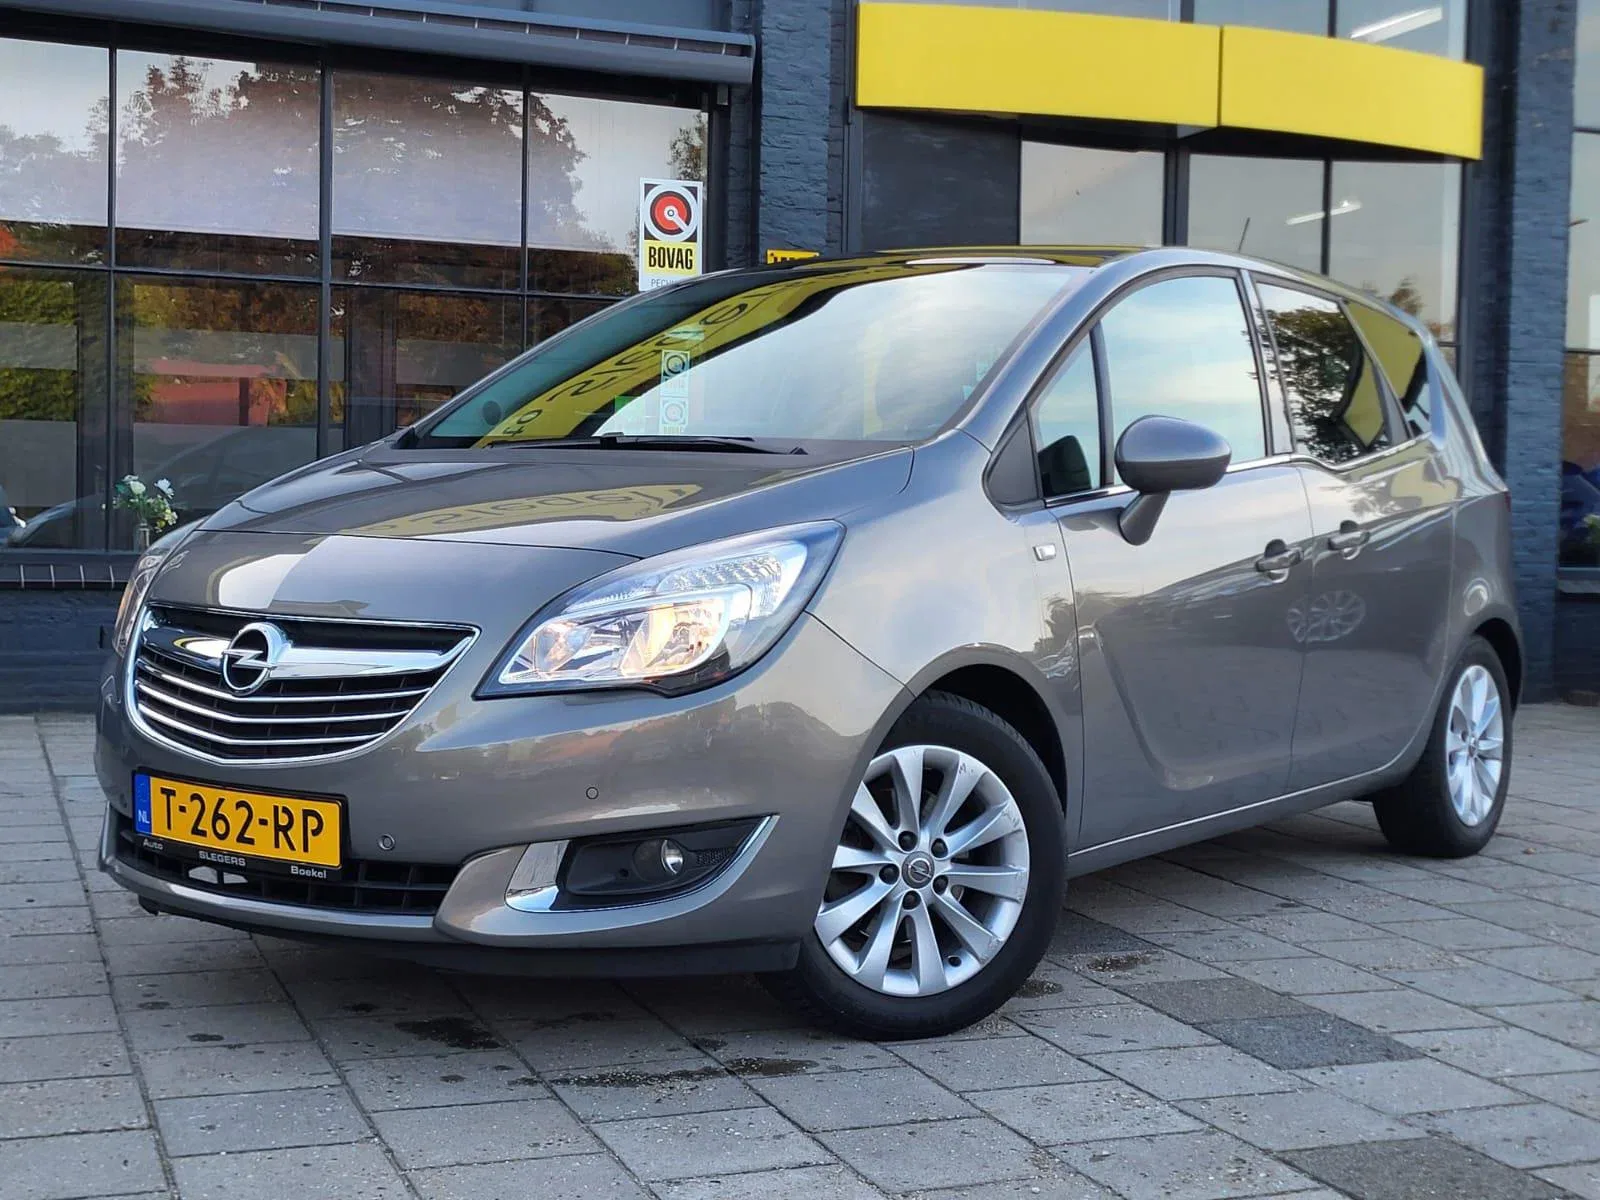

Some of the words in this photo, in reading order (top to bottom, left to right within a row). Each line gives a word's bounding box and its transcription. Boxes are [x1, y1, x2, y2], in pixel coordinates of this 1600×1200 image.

[648, 246, 693, 270] BOVAG
[137, 811, 151, 825] NL
[160, 786, 325, 853] T-262-RP
[142, 837, 164, 851] Auto
[198, 850, 247, 868] SLEGERS
[291, 864, 328, 880] Boekel
